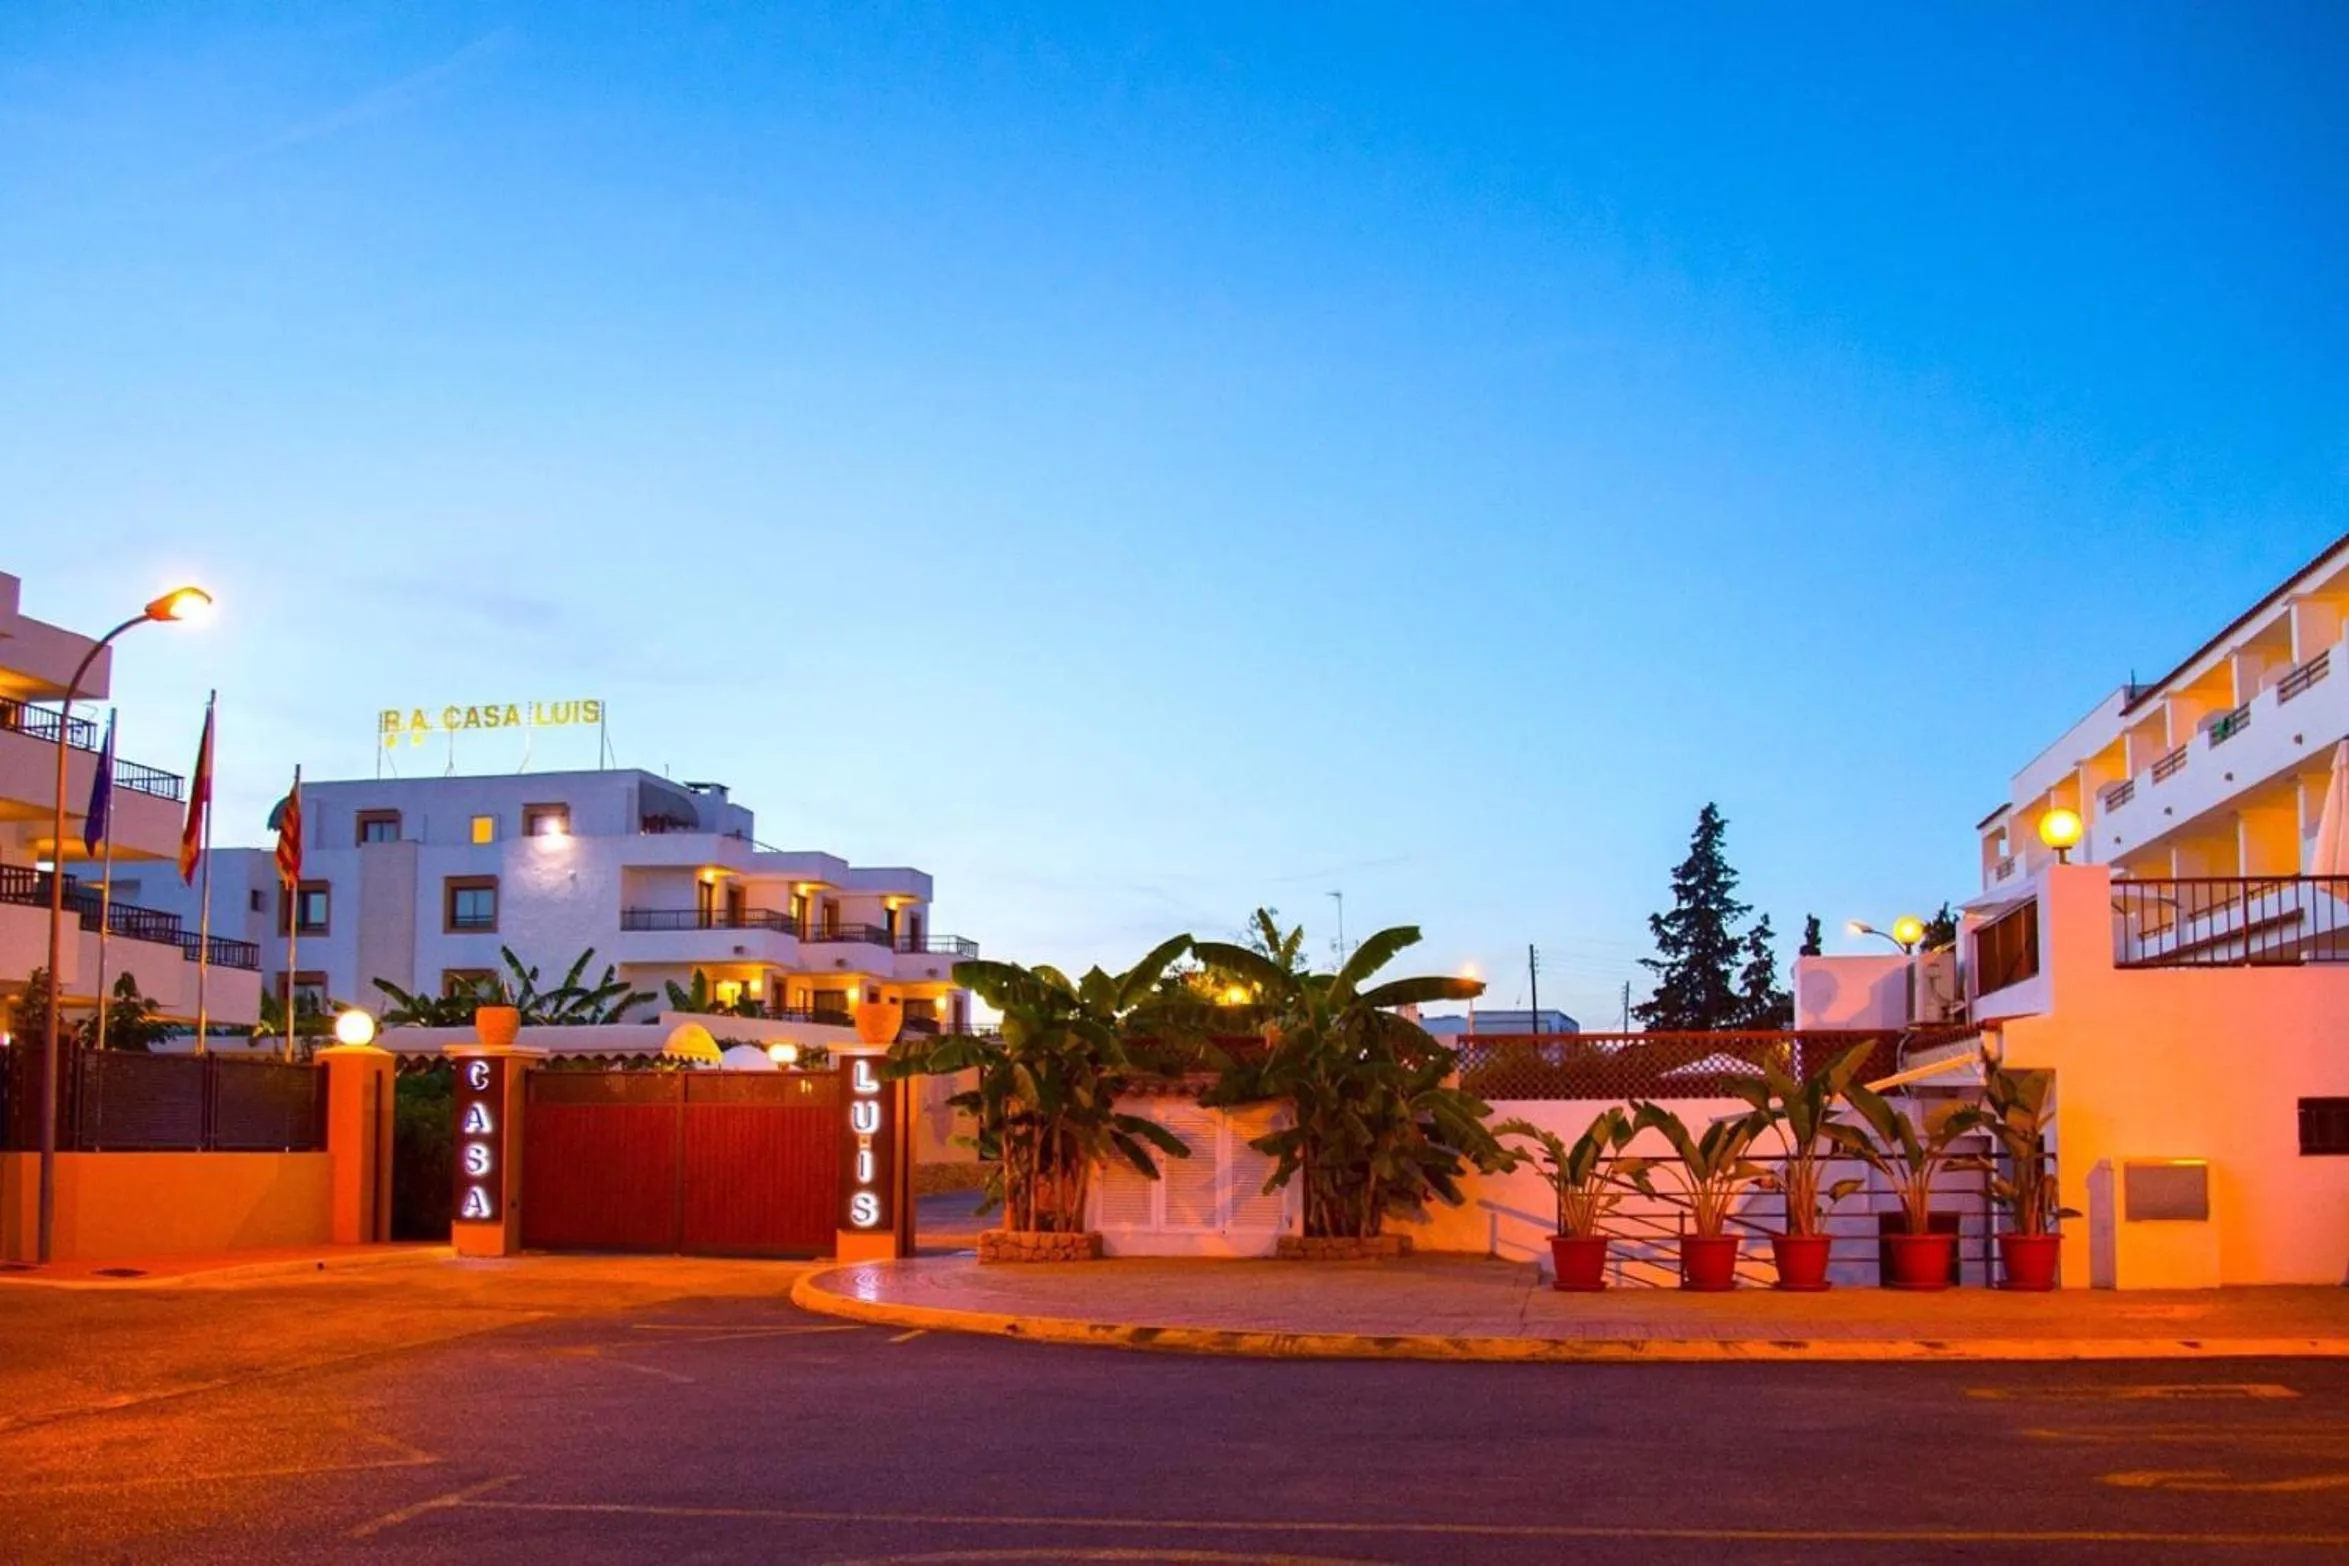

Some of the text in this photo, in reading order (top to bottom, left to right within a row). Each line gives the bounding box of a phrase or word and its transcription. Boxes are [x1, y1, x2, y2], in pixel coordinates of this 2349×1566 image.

[442, 705, 521, 729] CASA
[535, 699, 600, 725] LUIS
[463, 1060, 492, 1219] CASA
[850, 1058, 880, 1227] LUIS
